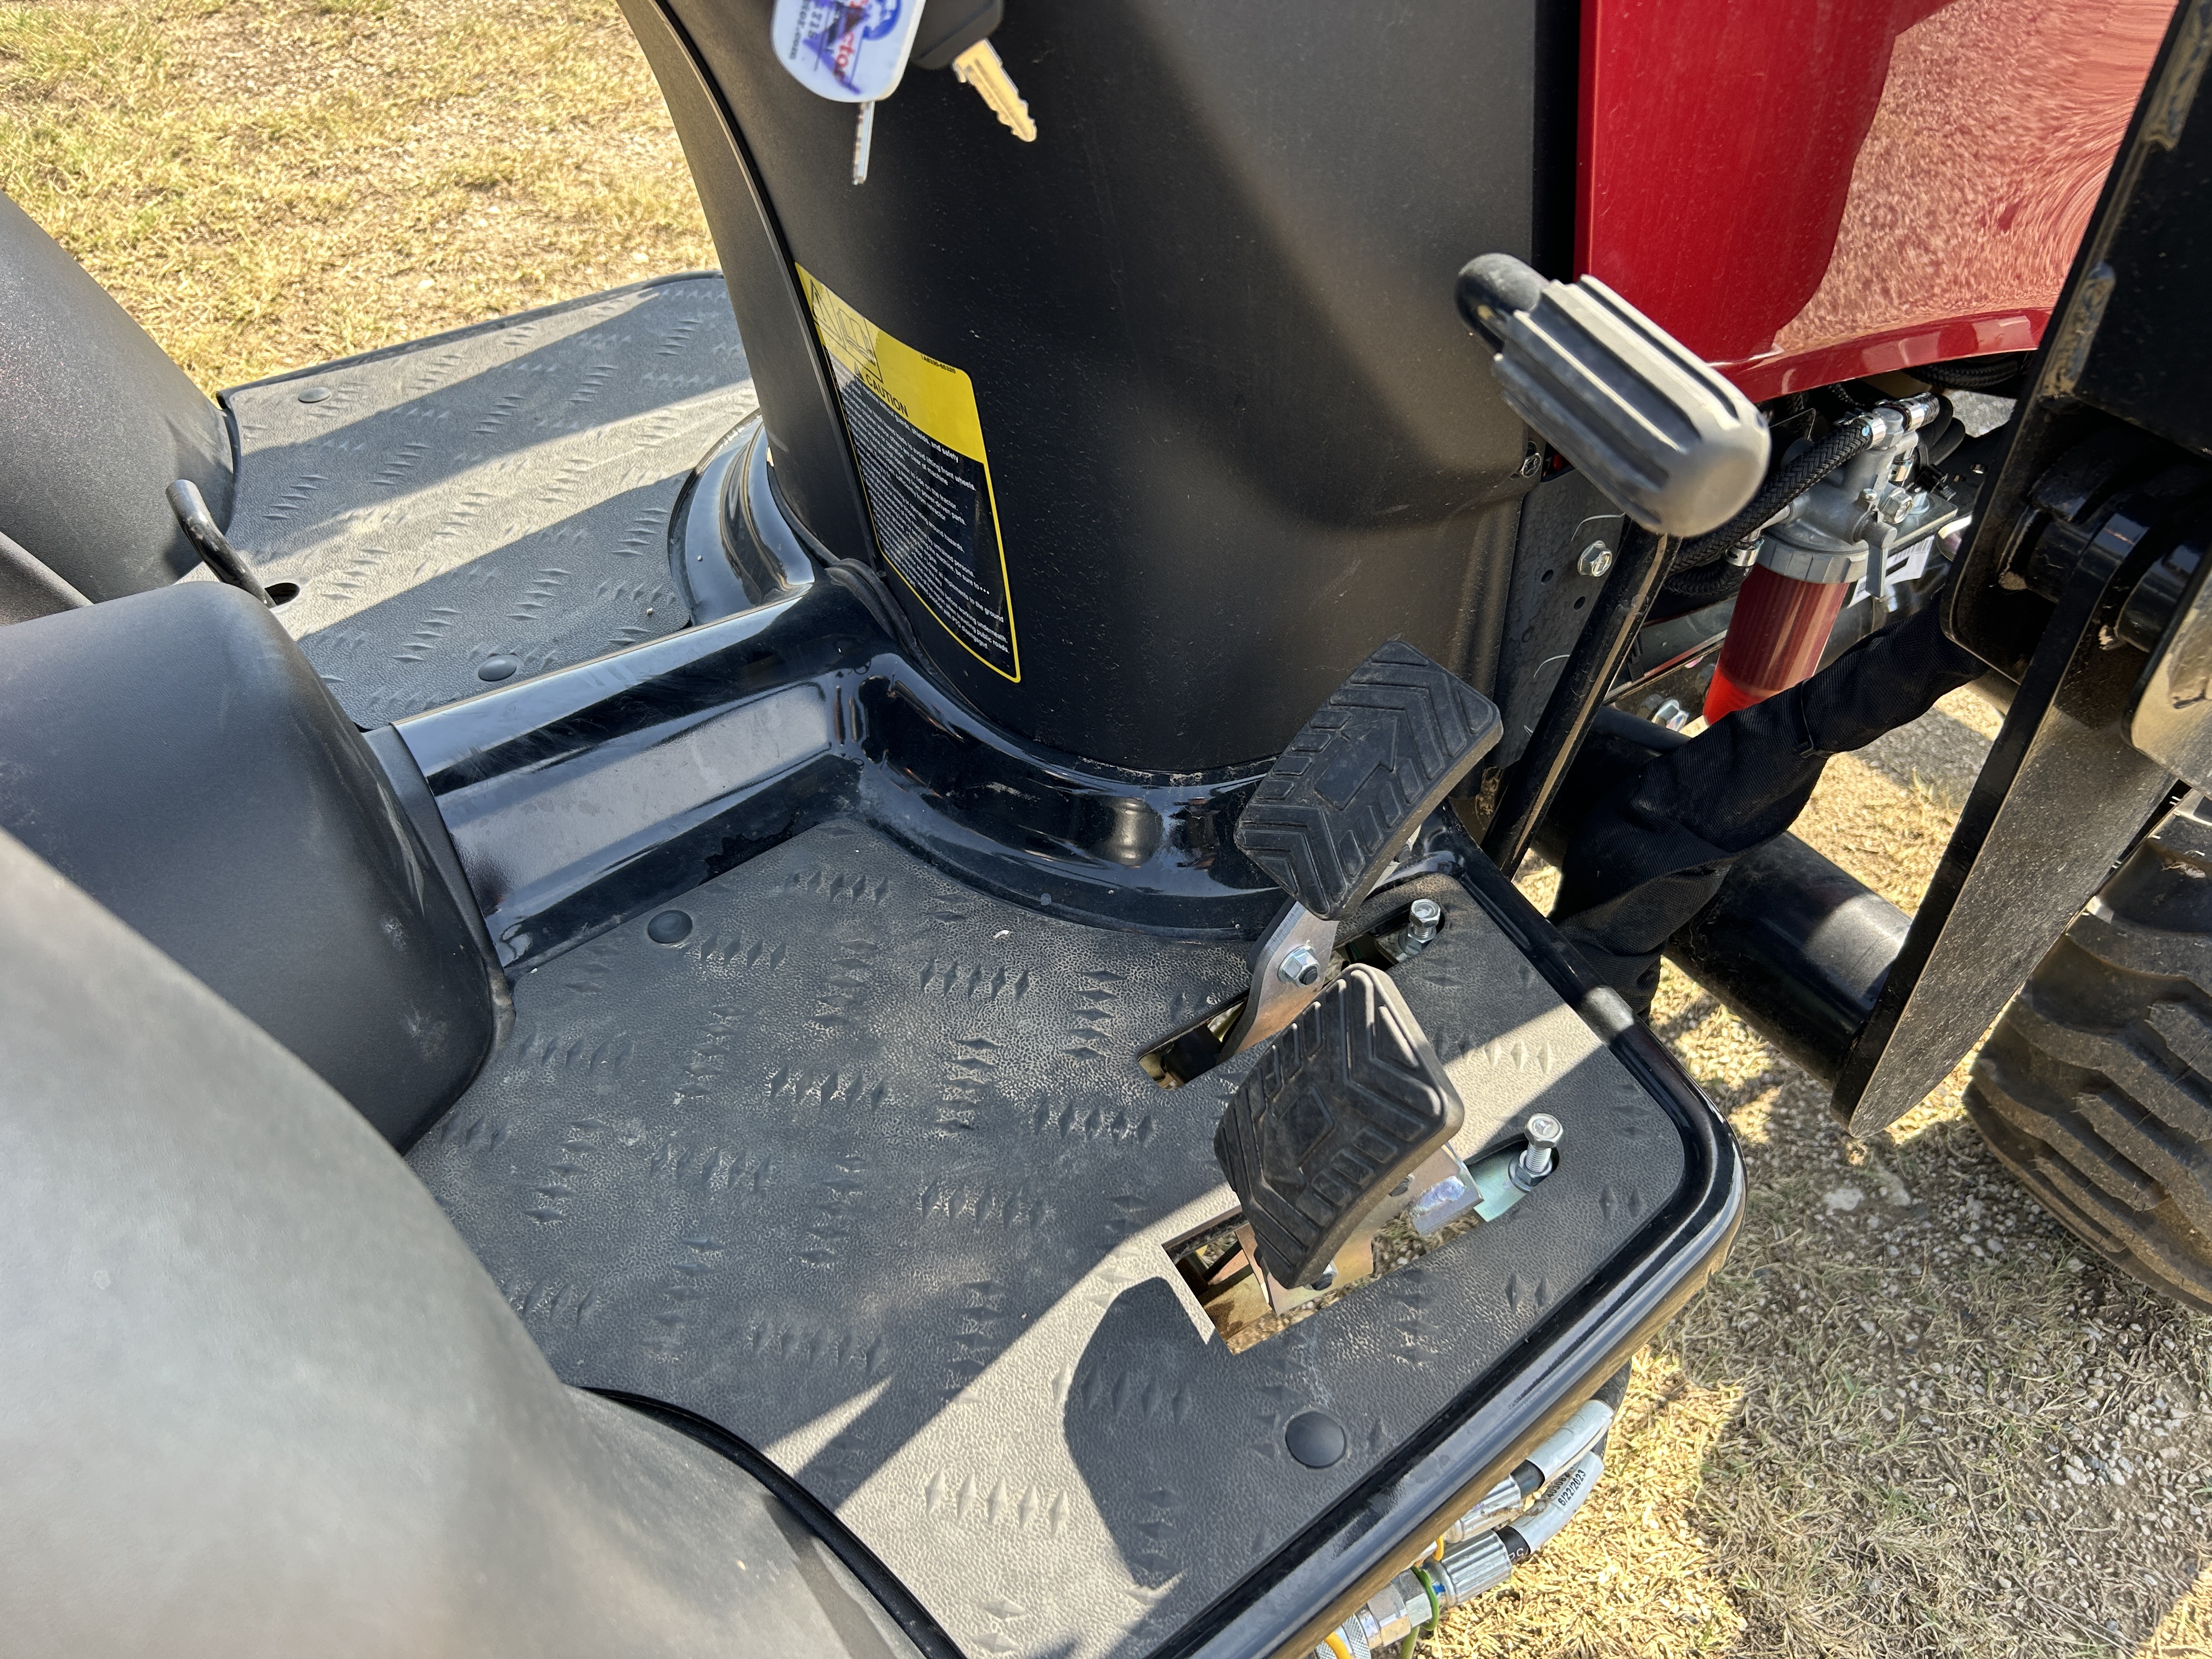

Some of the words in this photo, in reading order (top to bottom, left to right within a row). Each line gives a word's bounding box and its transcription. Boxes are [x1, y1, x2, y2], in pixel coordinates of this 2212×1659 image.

[865, 373, 909, 417] CAUTION
[984, 607, 1004, 623] ground
[1558, 1469, 1587, 1506] 6/22/2023
